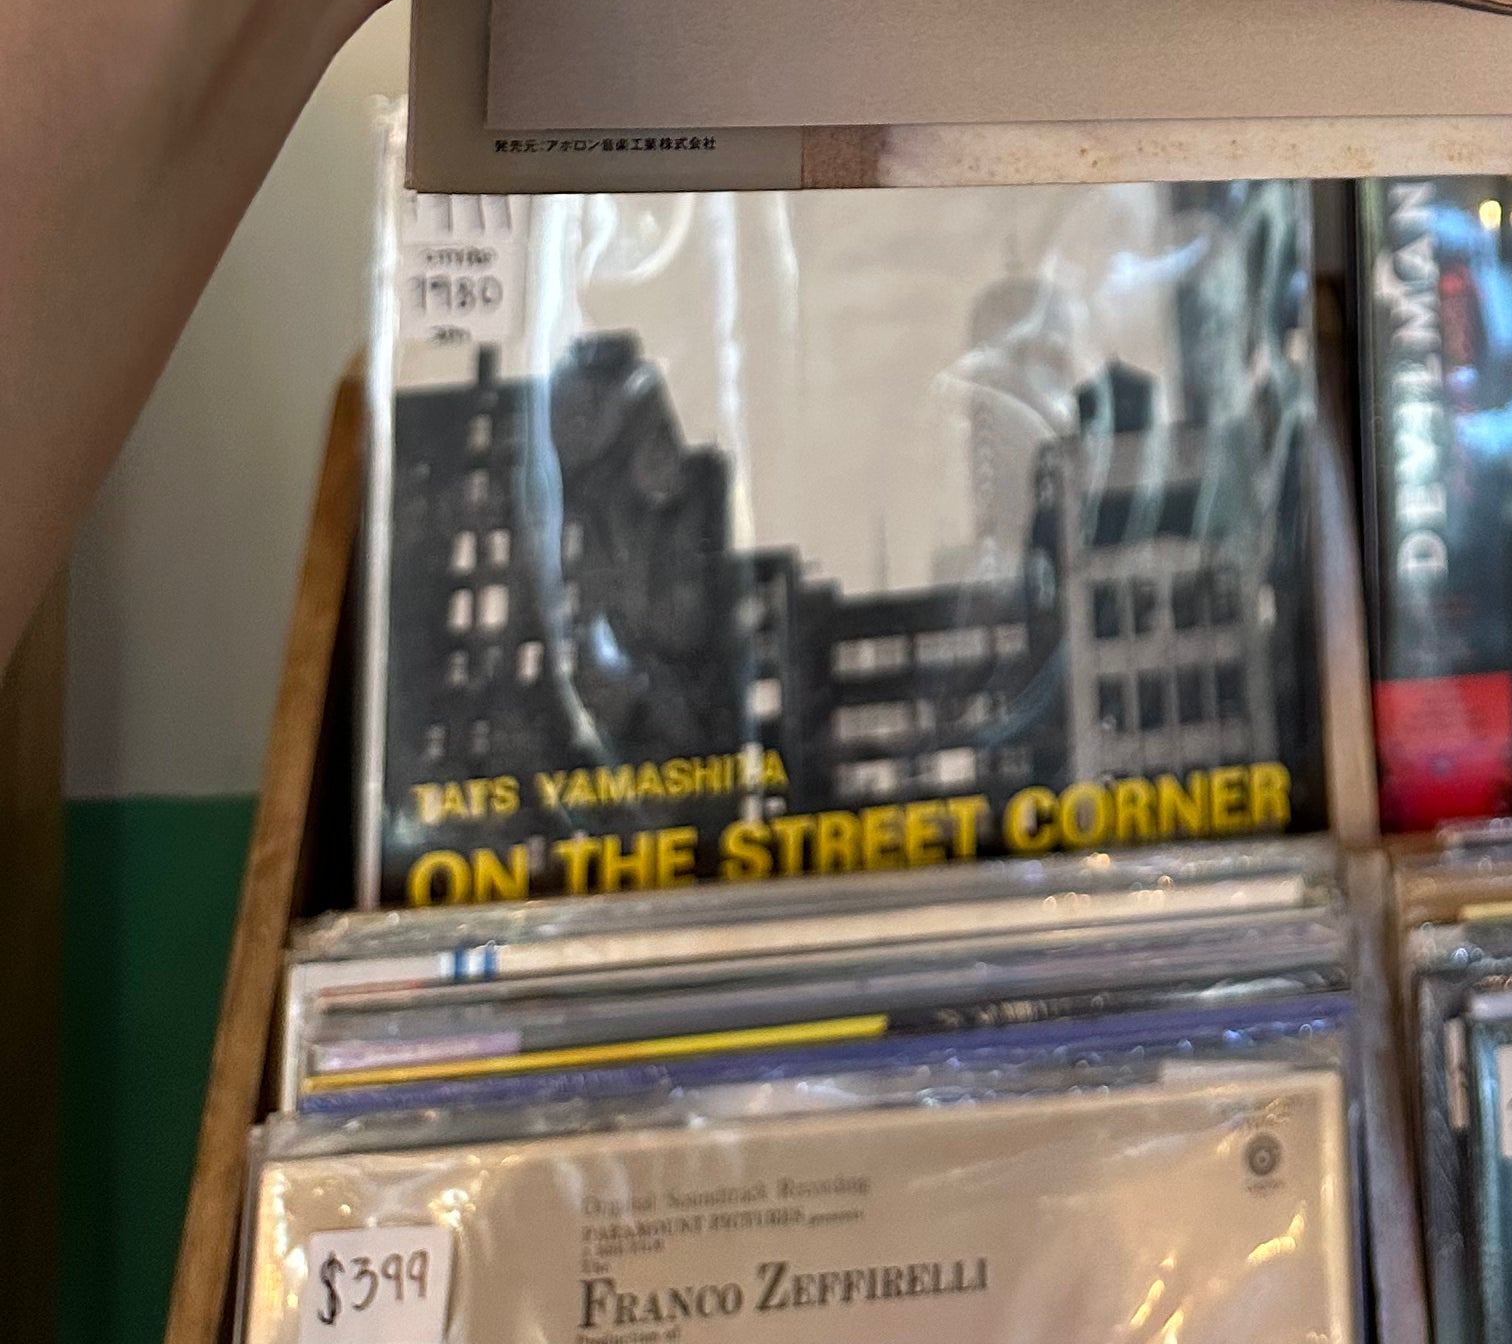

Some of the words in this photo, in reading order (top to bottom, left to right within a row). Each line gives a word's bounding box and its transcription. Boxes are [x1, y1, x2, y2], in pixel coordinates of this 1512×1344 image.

[407, 843, 531, 908] ON
[552, 826, 698, 896] THE
[720, 794, 993, 881] STREET
[1004, 761, 1293, 854] CORNER
[410, 776, 522, 824] TATS
[318, 1250, 430, 1326] $399
[577, 1275, 745, 1329] FRANCO
[754, 1256, 990, 1312] ZEFFIRELLI
